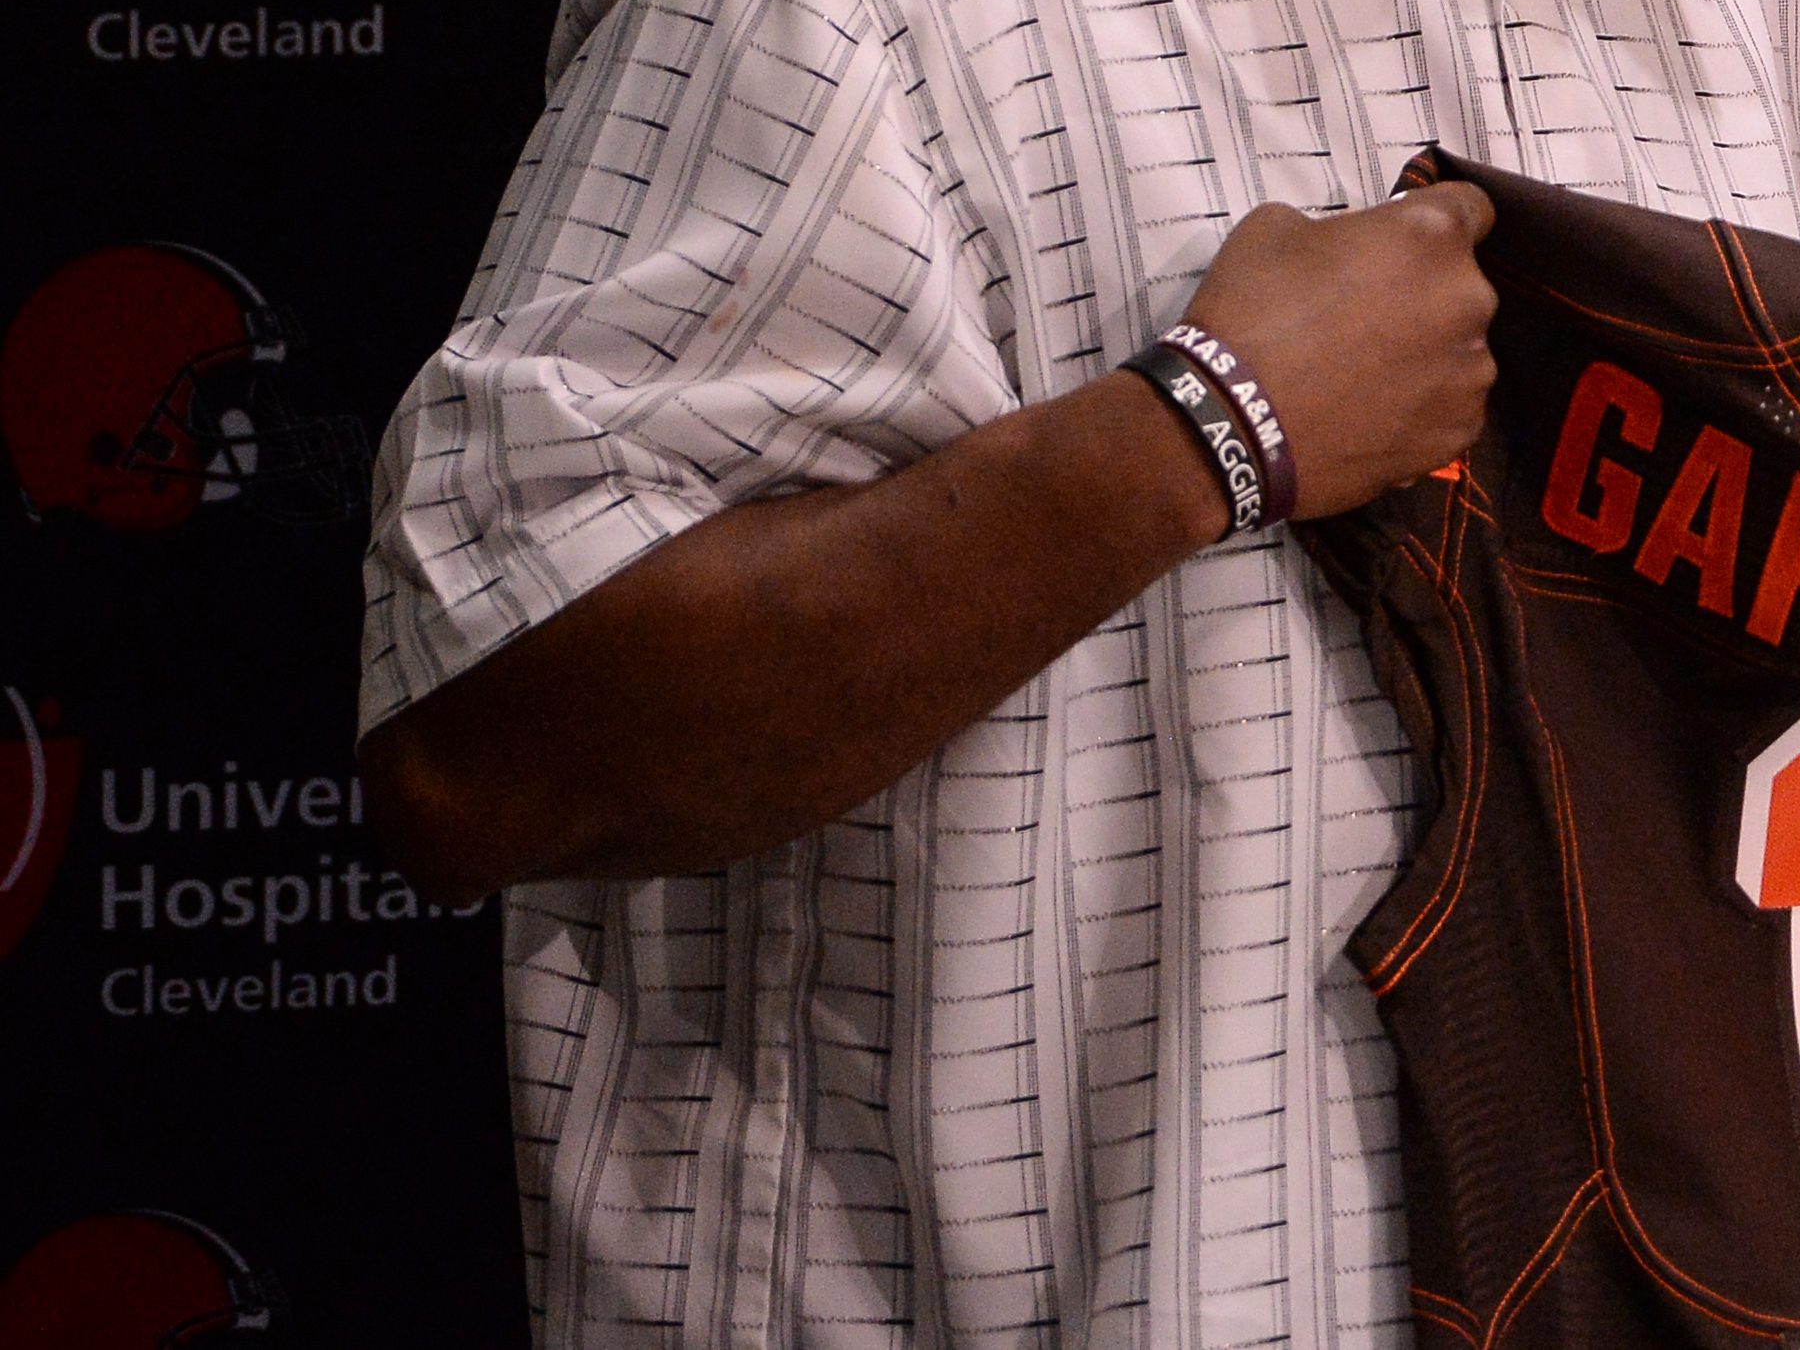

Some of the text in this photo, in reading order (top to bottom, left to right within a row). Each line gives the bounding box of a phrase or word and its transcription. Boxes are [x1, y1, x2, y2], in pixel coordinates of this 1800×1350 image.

[87, 4, 384, 61] Cleveland
[101, 854, 486, 944] Hospita
[100, 954, 397, 1017] Cleveland
